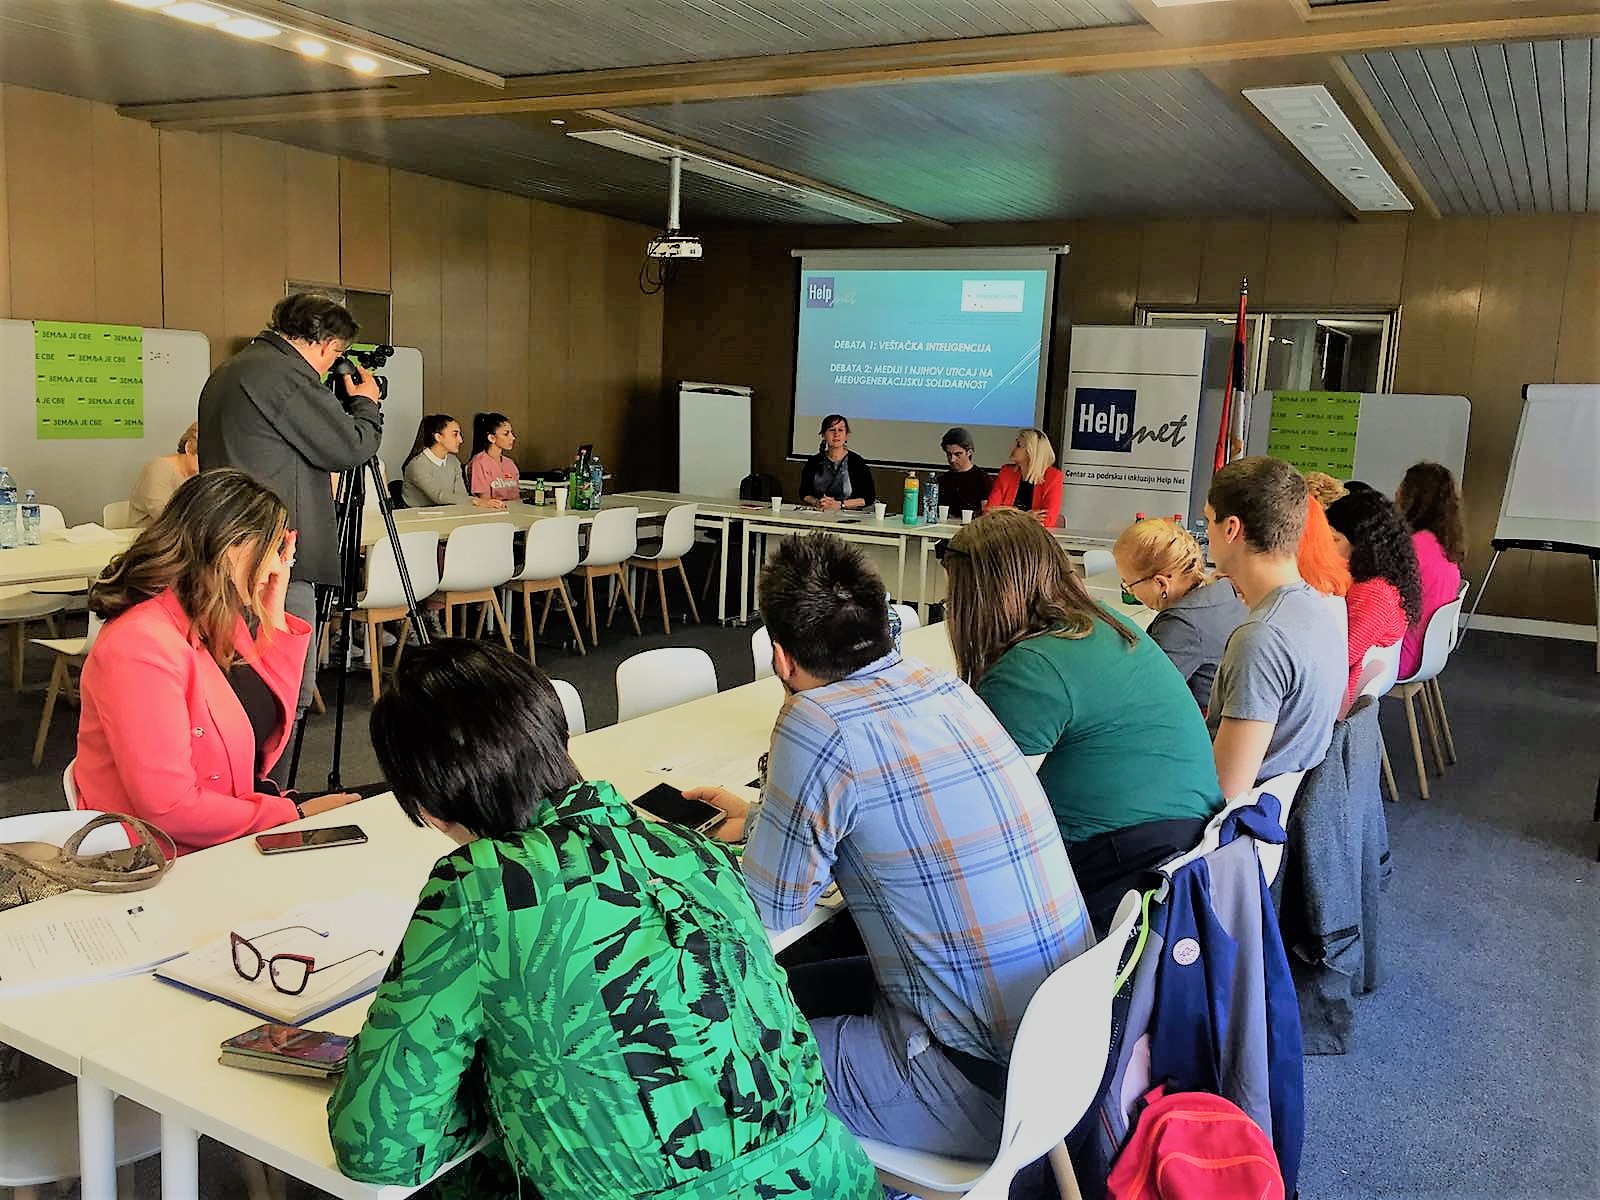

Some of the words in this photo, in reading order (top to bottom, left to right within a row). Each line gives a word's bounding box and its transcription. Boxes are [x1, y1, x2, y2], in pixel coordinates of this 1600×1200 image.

[809, 284, 832, 303] Help
[834, 340, 866, 350] DEBATA
[869, 340, 877, 350] 1:
[879, 339, 923, 352] VEŠTAČKA
[925, 342, 992, 353] INTELIGENCIJA
[829, 363, 862, 373] DEBATA
[863, 364, 873, 375] 2:
[873, 364, 902, 375] MEDIJI
[909, 366, 944, 376] NJIHOV
[945, 367, 978, 378] UTICAJ
[979, 368, 993, 378] NA
[834, 375, 924, 388] MEĐUGENERACIJSKU
[925, 378, 989, 390] SOLIDARNOST
[1078, 402, 1130, 442] Help
[1130, 414, 1188, 448] net
[1065, 469, 1086, 479] Centar
[1127, 474, 1155, 485] inkluziju
[1156, 475, 1172, 485] Help
[1172, 476, 1185, 486] Net
